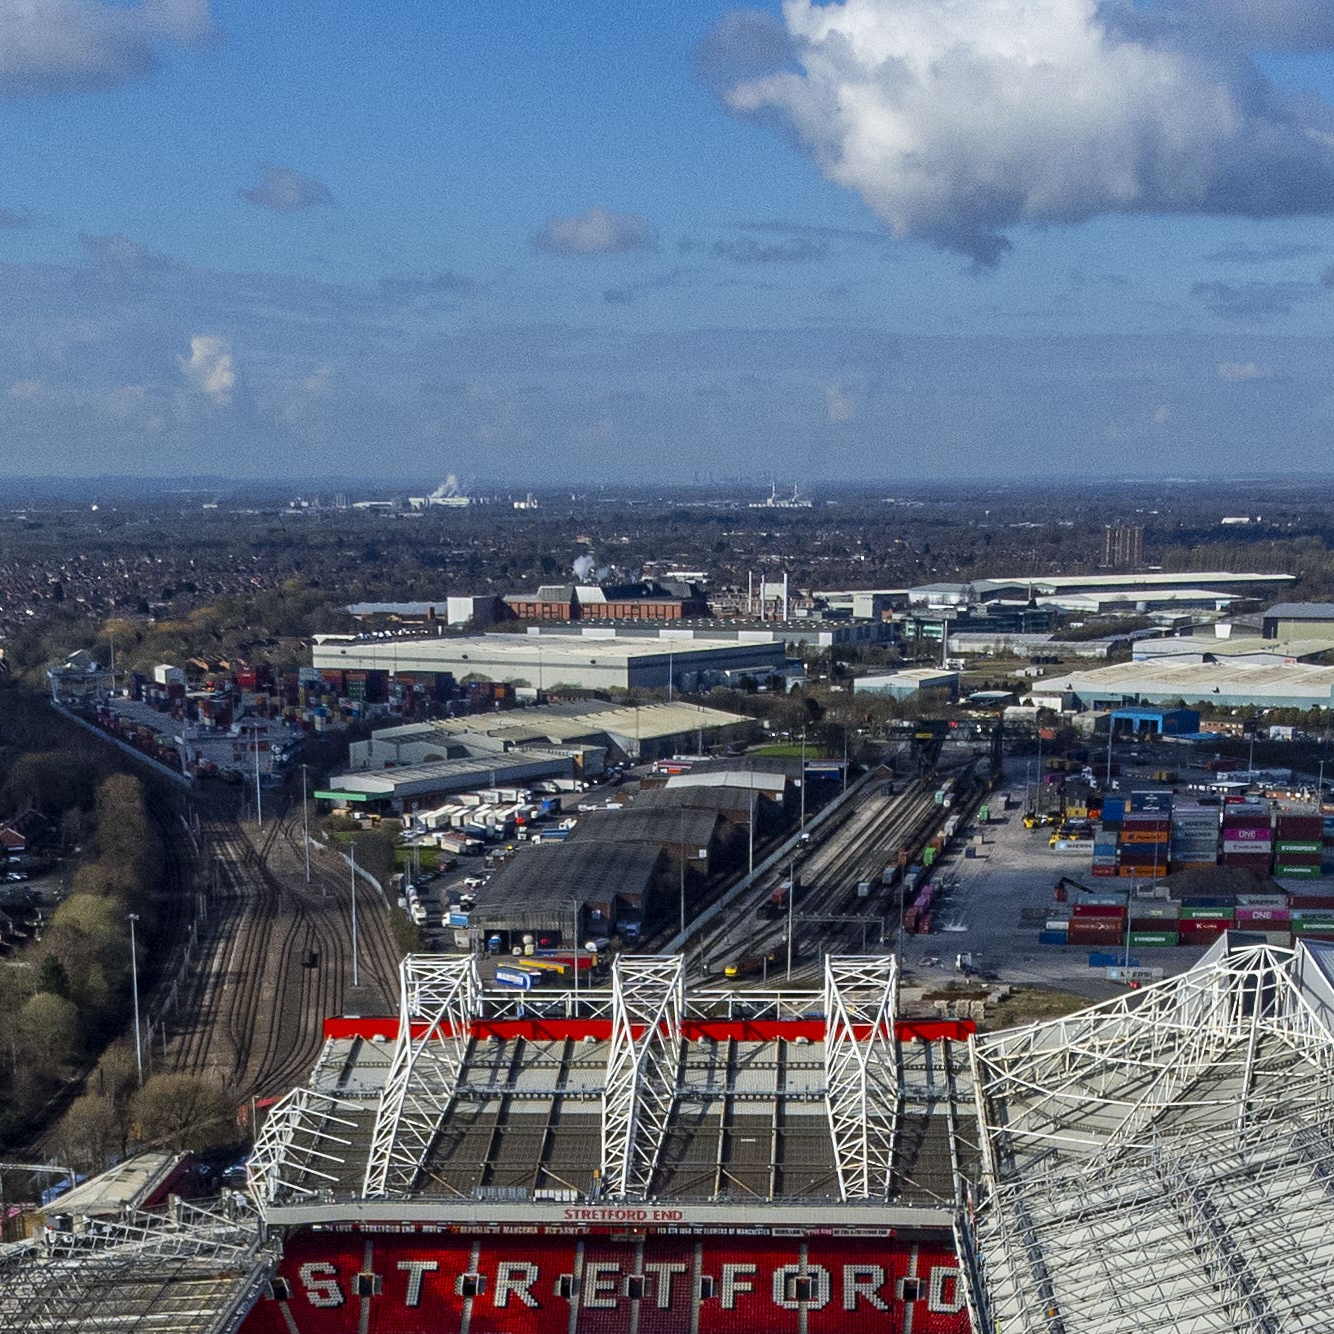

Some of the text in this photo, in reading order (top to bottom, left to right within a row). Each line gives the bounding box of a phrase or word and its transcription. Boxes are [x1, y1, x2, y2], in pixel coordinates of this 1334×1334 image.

[1252, 911, 1272, 919] ONE
[564, 1208, 683, 1221] STRETFORD END
[299, 1260, 966, 1313] STRETFORD
